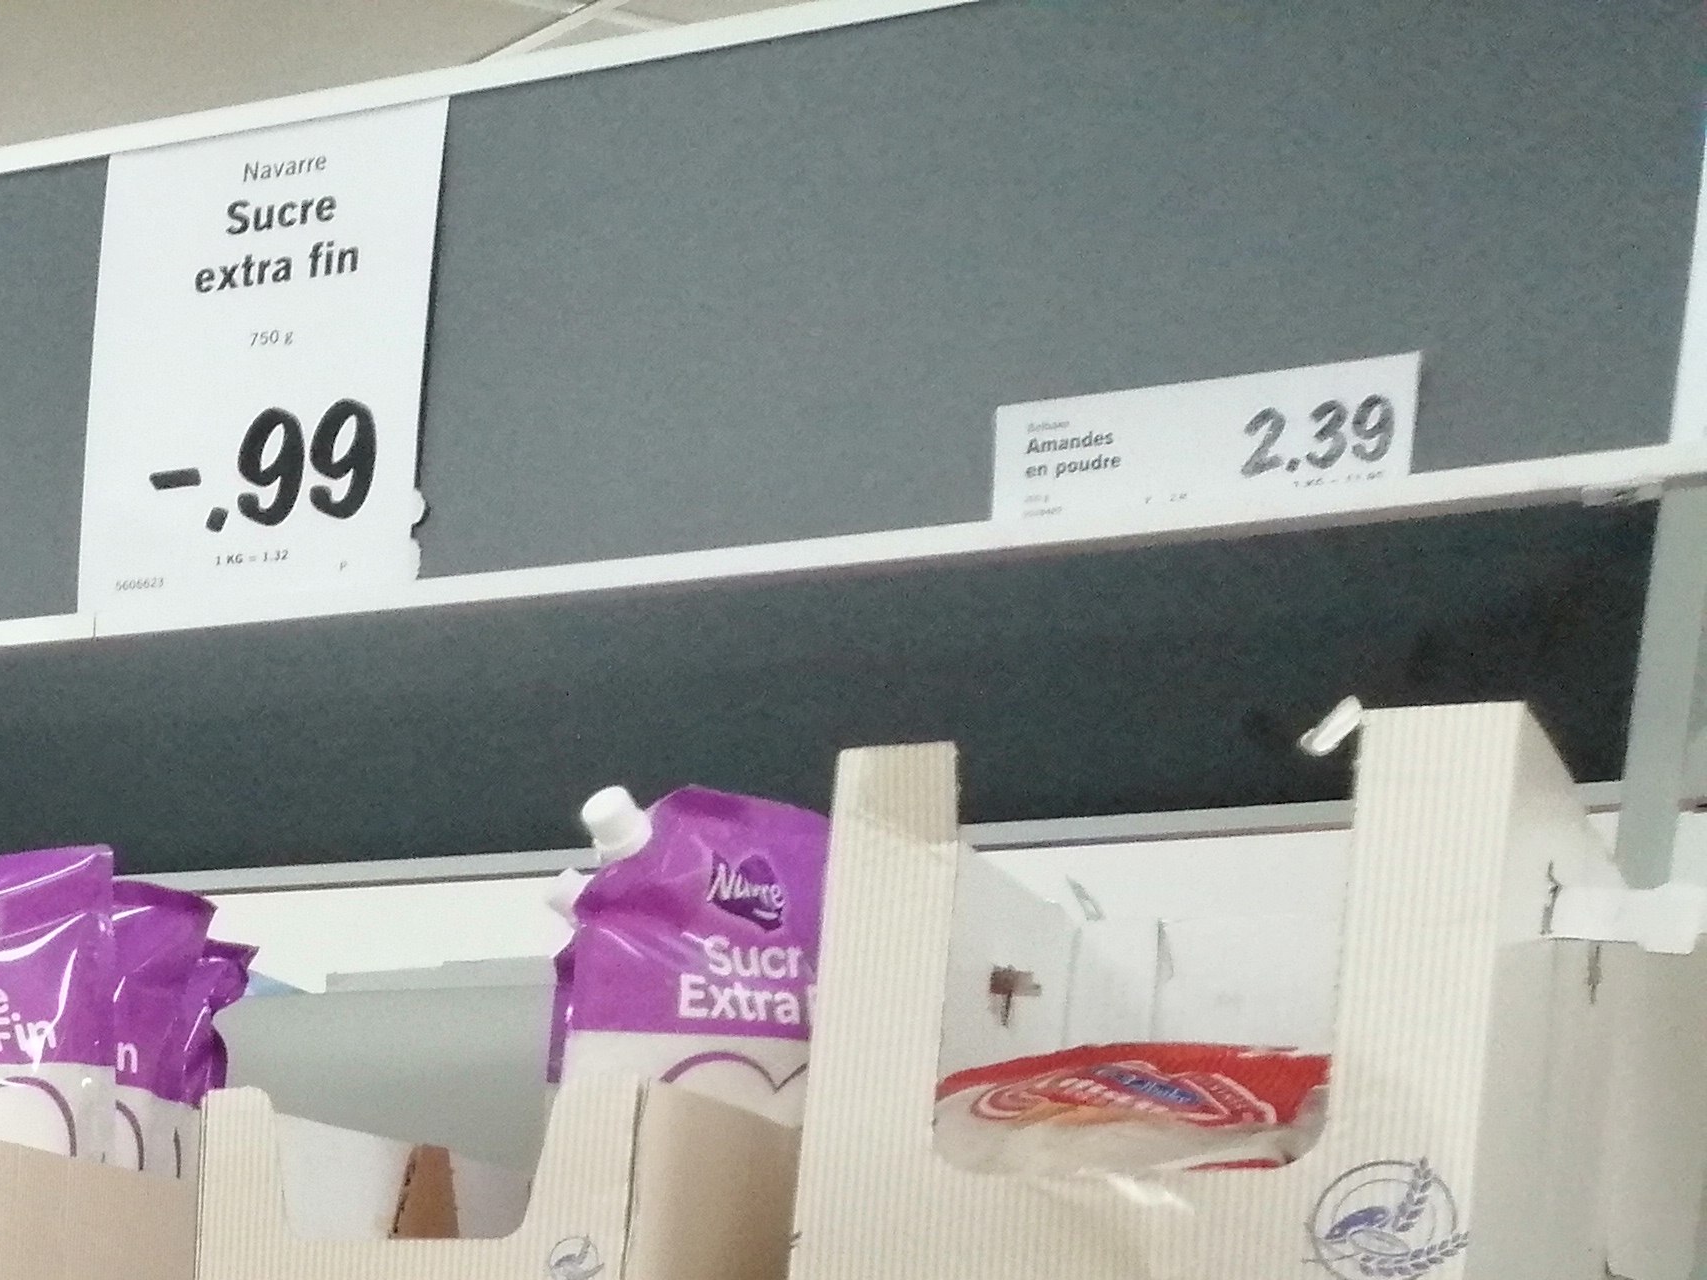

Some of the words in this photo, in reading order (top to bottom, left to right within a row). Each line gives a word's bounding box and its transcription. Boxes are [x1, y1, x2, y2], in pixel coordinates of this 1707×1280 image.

[244, 155, 327, 183] Navarre
[225, 194, 337, 235] Sucre
[194, 254, 292, 294] extra
[309, 242, 360, 279] fin
[249, 331, 279, 346] 750
[1026, 430, 1113, 454] Amandes
[1241, 394, 1394, 478] 2.39
[150, 398, 376, 533] -.99
[1026, 463, 1048, 478] en
[1055, 454, 1121, 479] poudre
[226, 553, 243, 565] KG
[677, 973, 800, 1025] Extra
